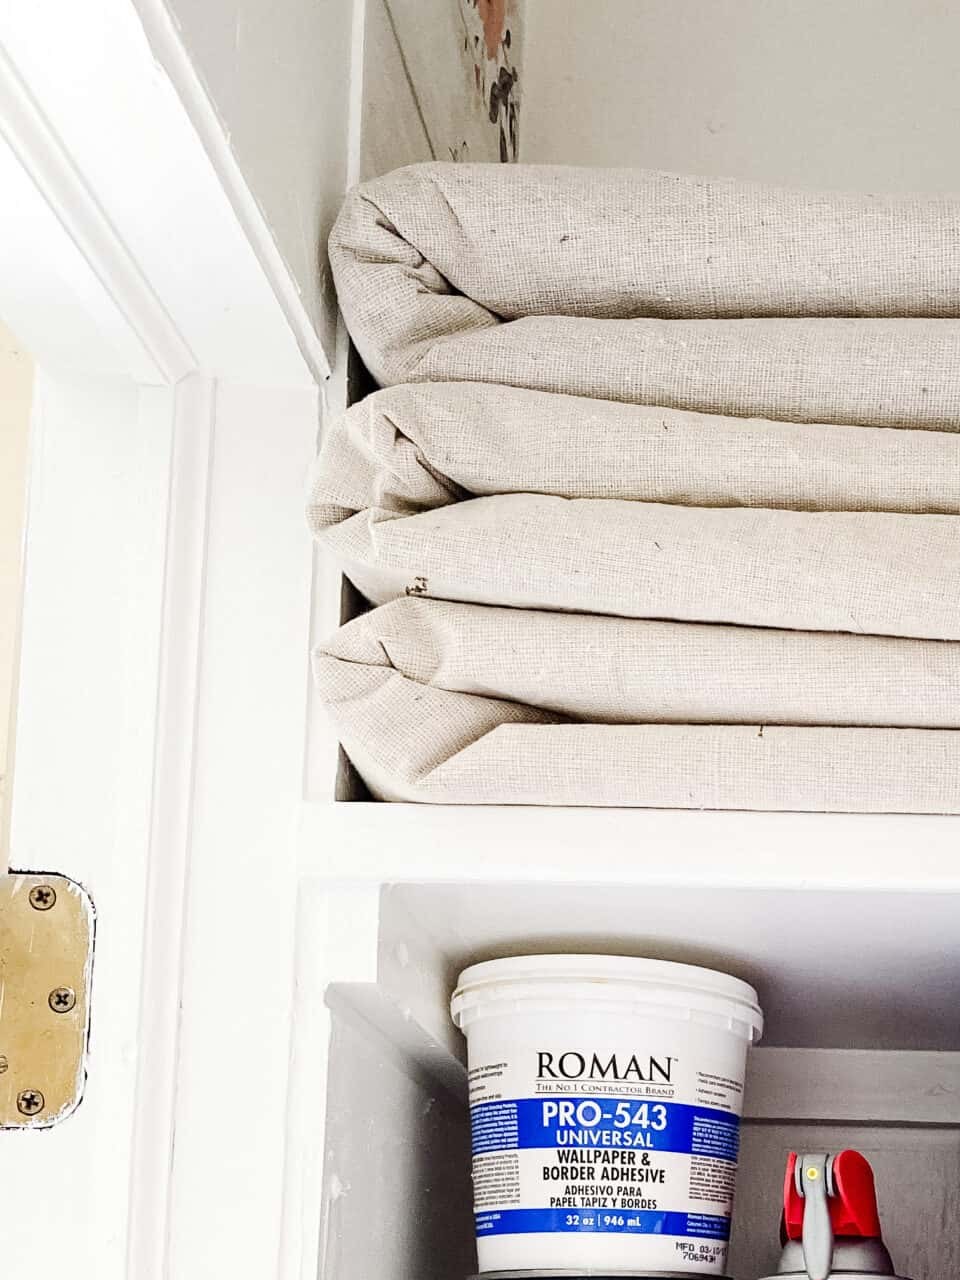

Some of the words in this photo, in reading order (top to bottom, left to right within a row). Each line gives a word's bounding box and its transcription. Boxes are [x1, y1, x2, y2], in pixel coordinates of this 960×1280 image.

[536, 1052, 672, 1082] ROMAN
[542, 1101, 667, 1130] PRO-543
[556, 1130, 654, 1146] UNIVERSAL
[557, 1150, 636, 1165] WALLPAPER
[641, 1152, 651, 1165] &
[543, 1167, 595, 1180] BORDER
[601, 1168, 665, 1183] ADHESIVE
[564, 1185, 613, 1195] ADHESIVO
[617, 1186, 642, 1196] PARA
[550, 1197, 576, 1207] PAPEL
[581, 1198, 607, 1207] TAPIZ
[611, 1199, 617, 1208] Y
[621, 1199, 657, 1209] BORDES
[565, 1215, 579, 1225] 32
[582, 1217, 594, 1225] oz
[604, 1216, 624, 1226] 946
[627, 1216, 642, 1226] mL
